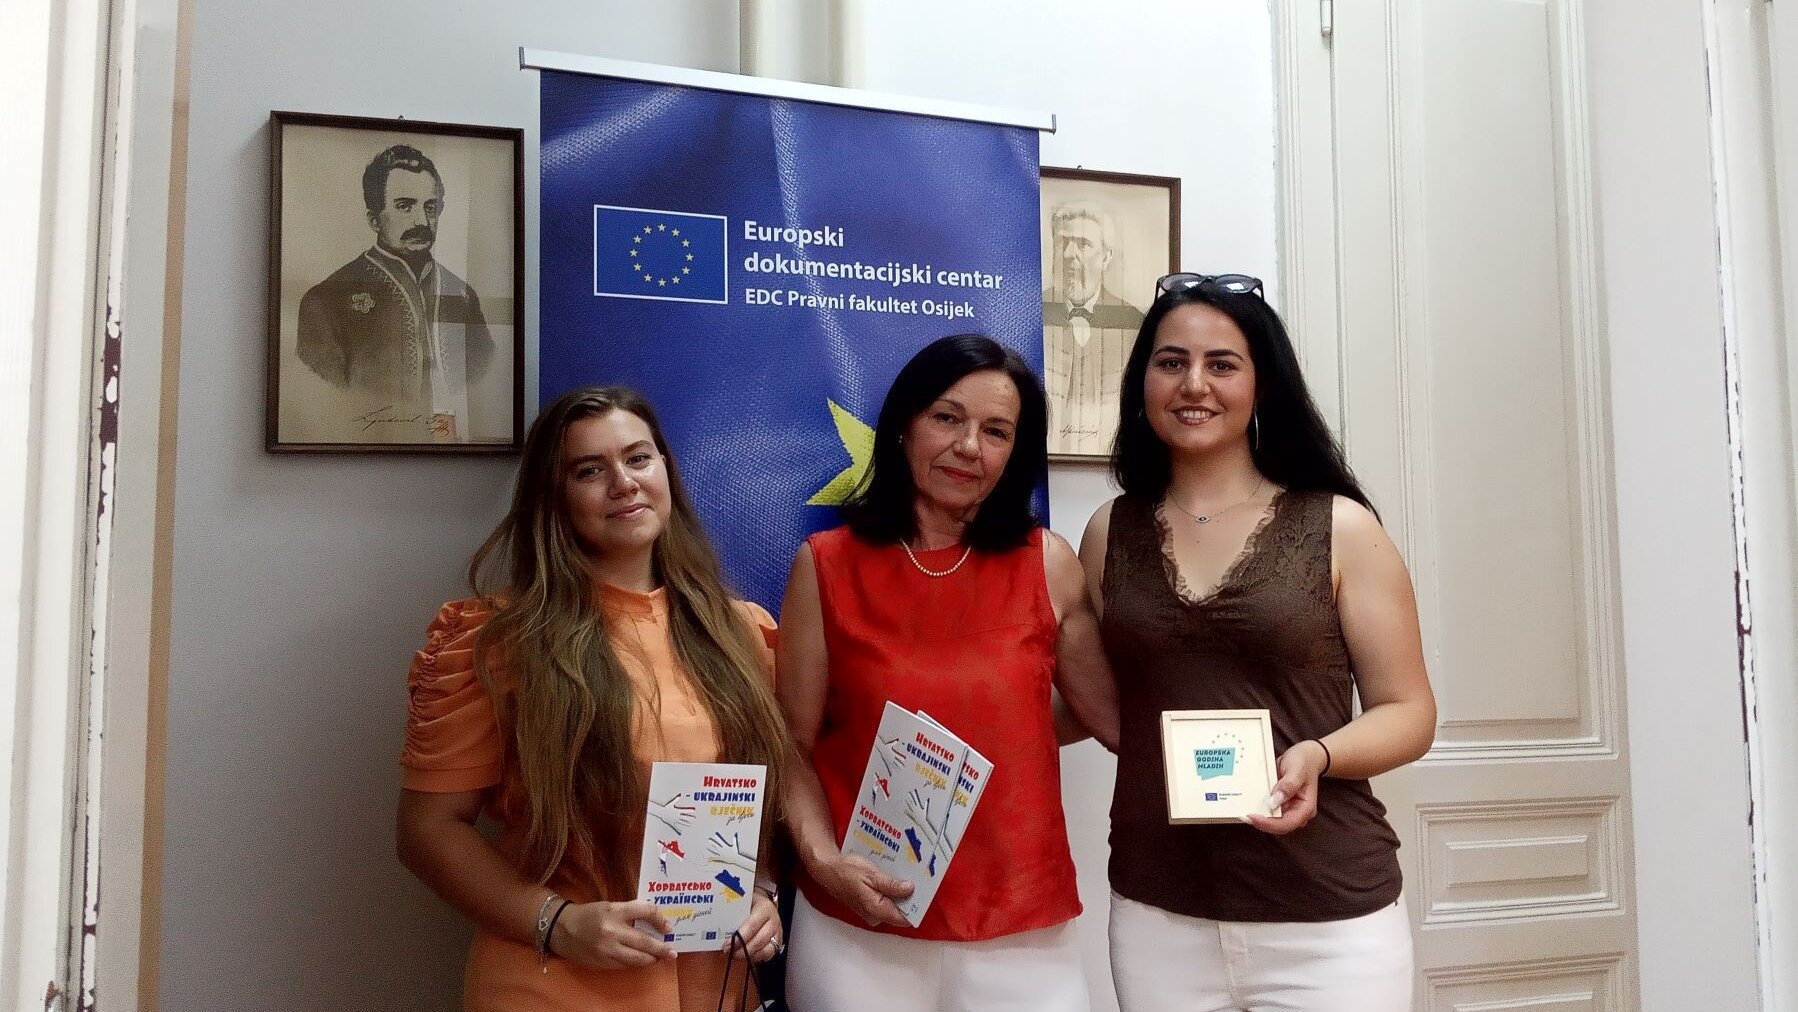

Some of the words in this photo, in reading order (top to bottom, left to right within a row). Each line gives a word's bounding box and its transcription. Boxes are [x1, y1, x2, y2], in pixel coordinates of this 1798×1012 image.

[744, 220, 844, 248] Europski
[744, 252, 931, 287] dokumentacijski
[936, 270, 1003, 289] centar
[745, 288, 783, 306] EDC
[788, 291, 844, 310] Pravni
[849, 294, 917, 314] fakultet
[921, 300, 975, 320] Osijek
[906, 743, 951, 776] UKRAJINSKI
[693, 791, 756, 802] UKRAJINSKI
[703, 776, 757, 788] HRVATSKO
[860, 821, 901, 853] УКРАЇНСЬКІ
[654, 892, 714, 905] УКРАЇНСЬКІ
